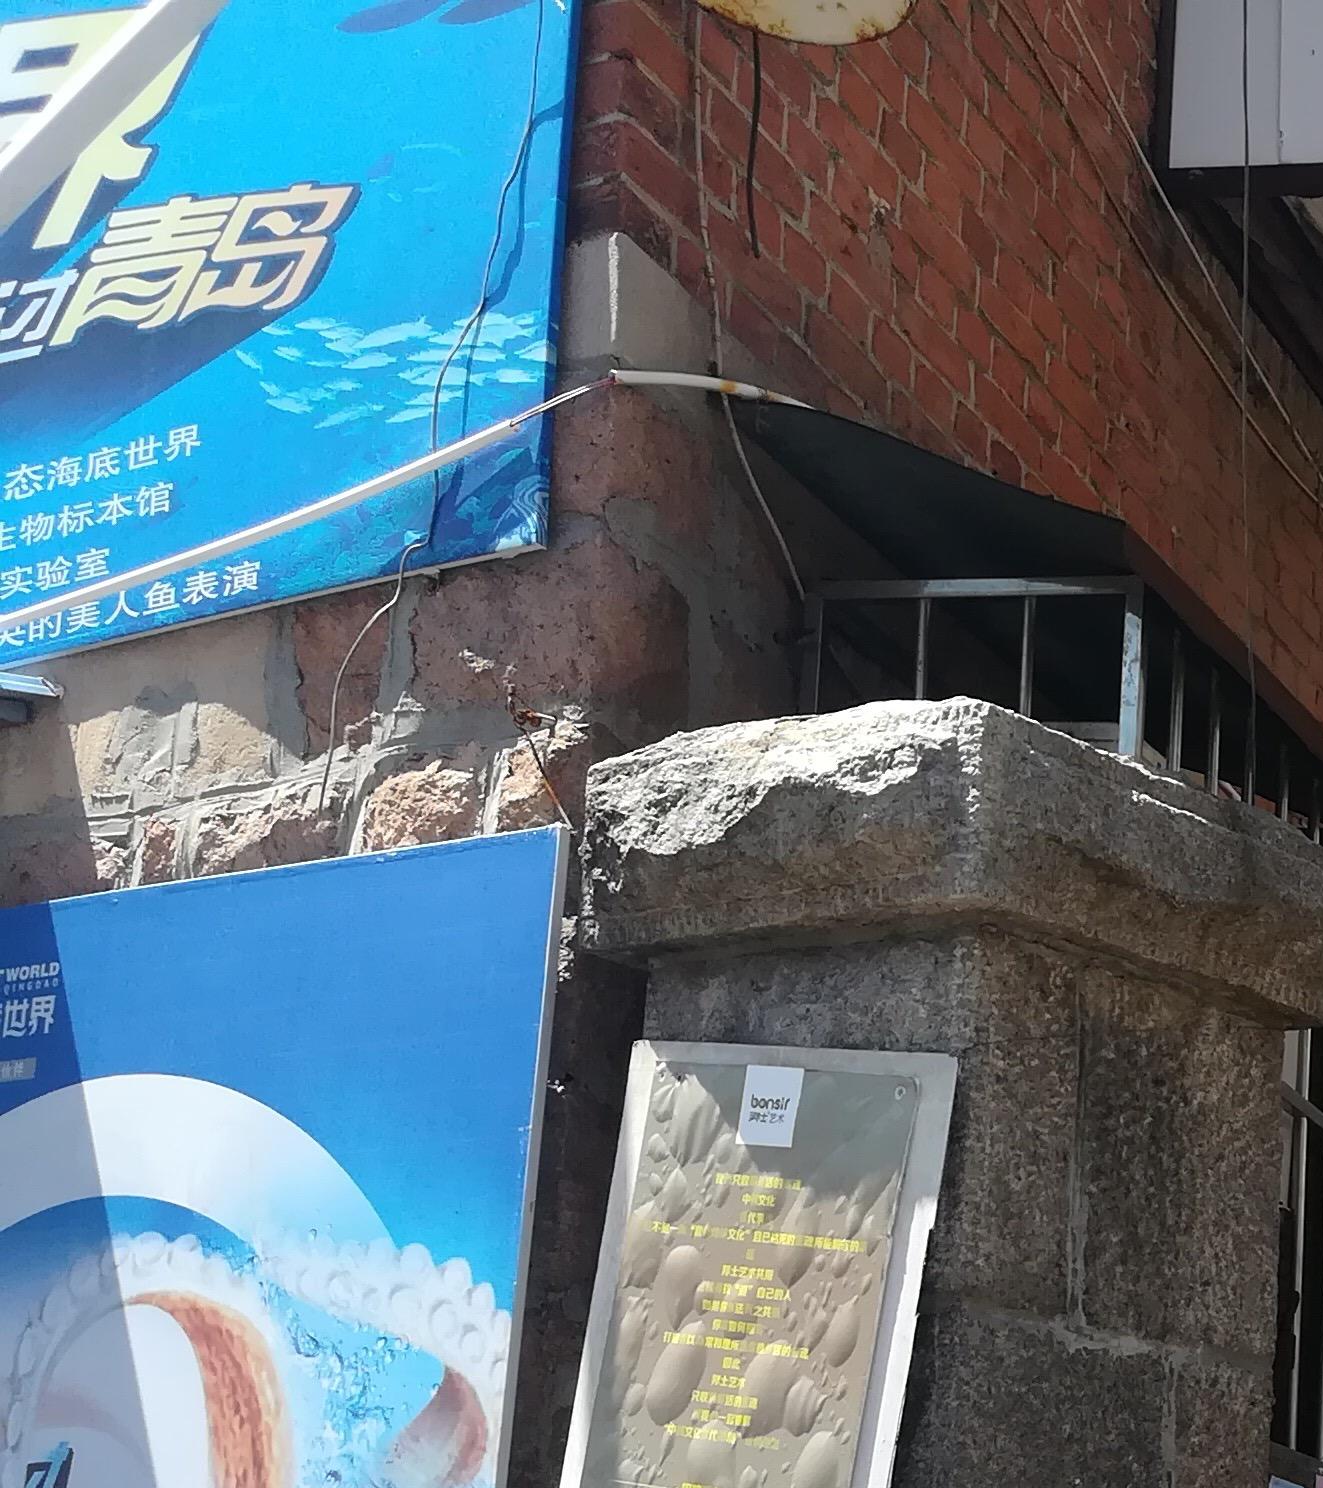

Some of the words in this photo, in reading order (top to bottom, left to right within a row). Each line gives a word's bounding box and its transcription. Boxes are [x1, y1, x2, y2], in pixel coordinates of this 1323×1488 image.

[4, 424, 201, 500] 态海底世界
[0, 548, 110, 601] 实验室
[6, 962, 60, 982] WORLD
[0, 995, 56, 1038] 世界
[750, 1094, 791, 1111] bonsir
